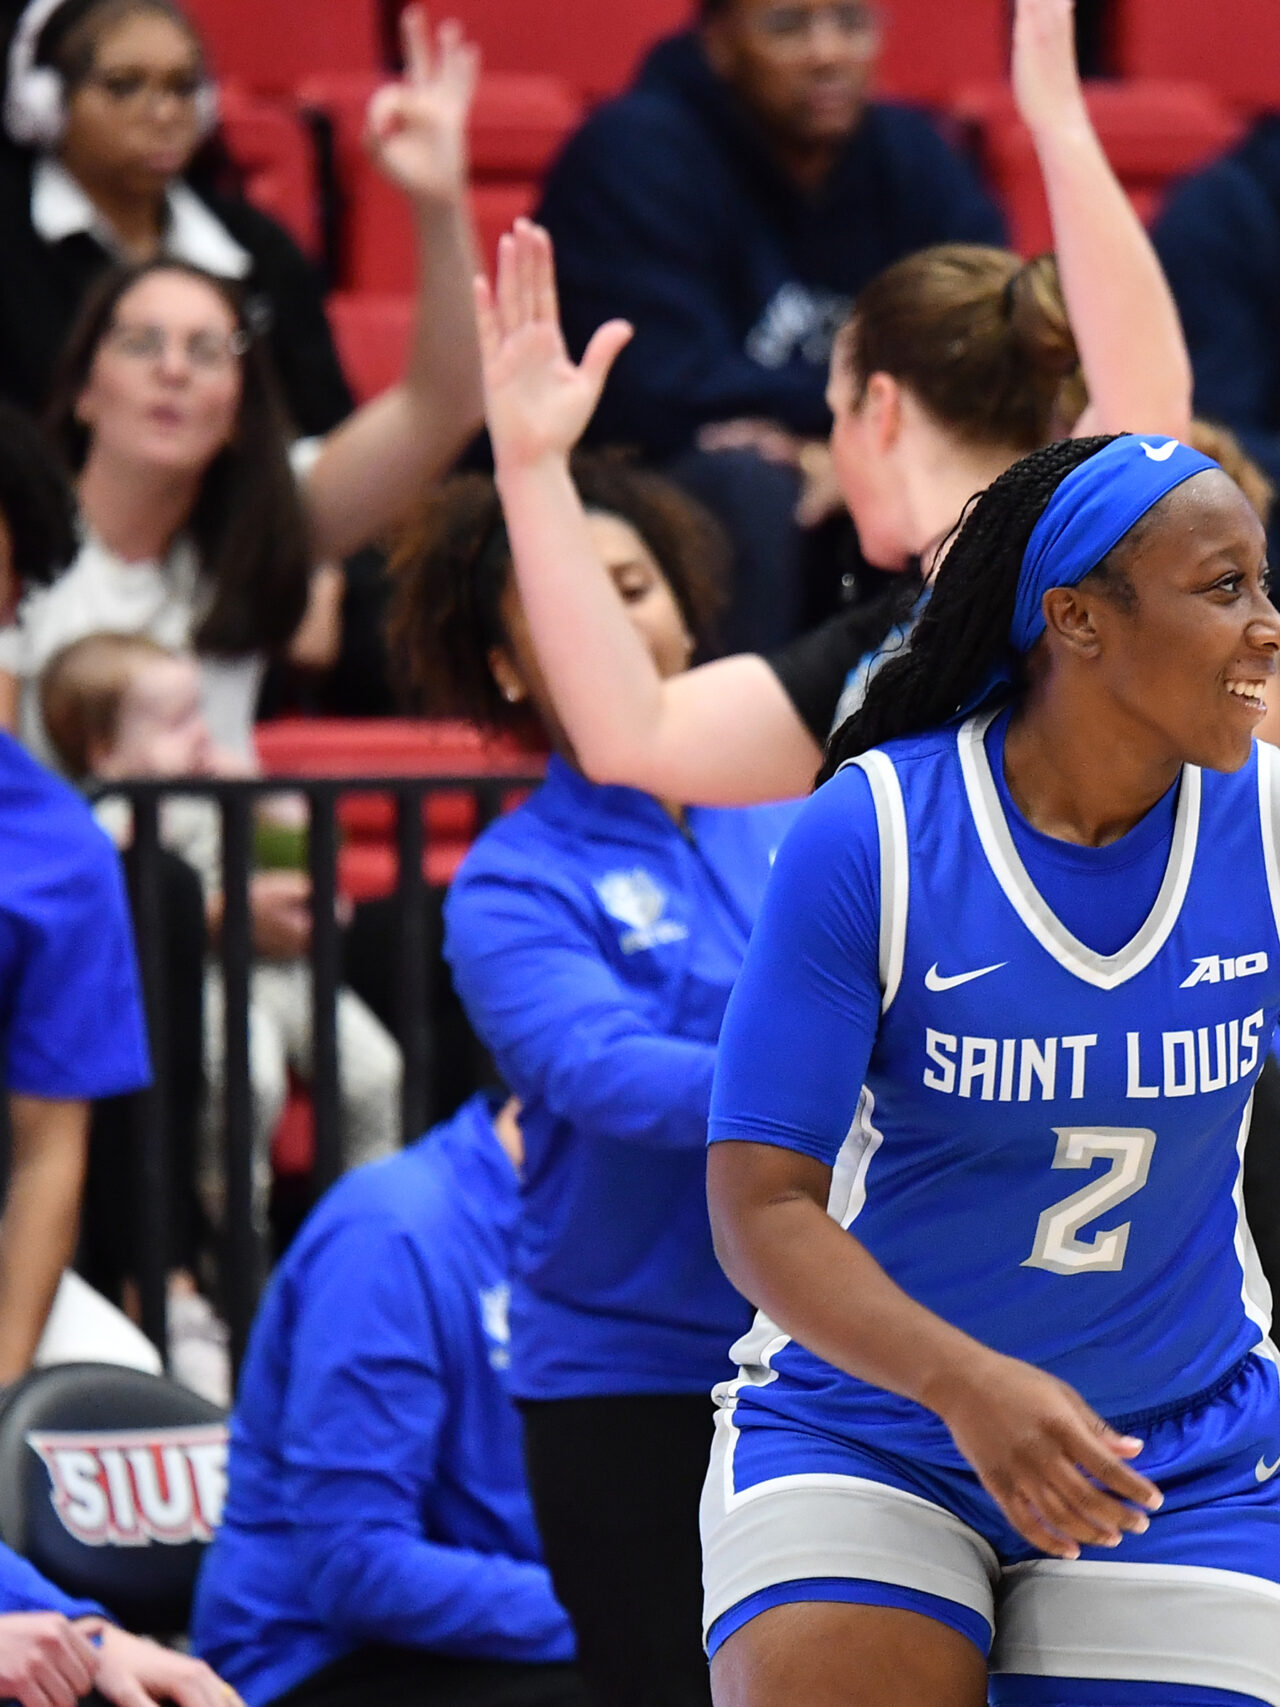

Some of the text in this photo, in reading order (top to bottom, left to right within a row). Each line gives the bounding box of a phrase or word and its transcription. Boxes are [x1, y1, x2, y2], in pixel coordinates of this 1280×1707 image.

[1179, 951, 1269, 989] A10
[923, 1008, 1264, 1102] SAINT LOUIS
[1019, 1126, 1157, 1275] 2
